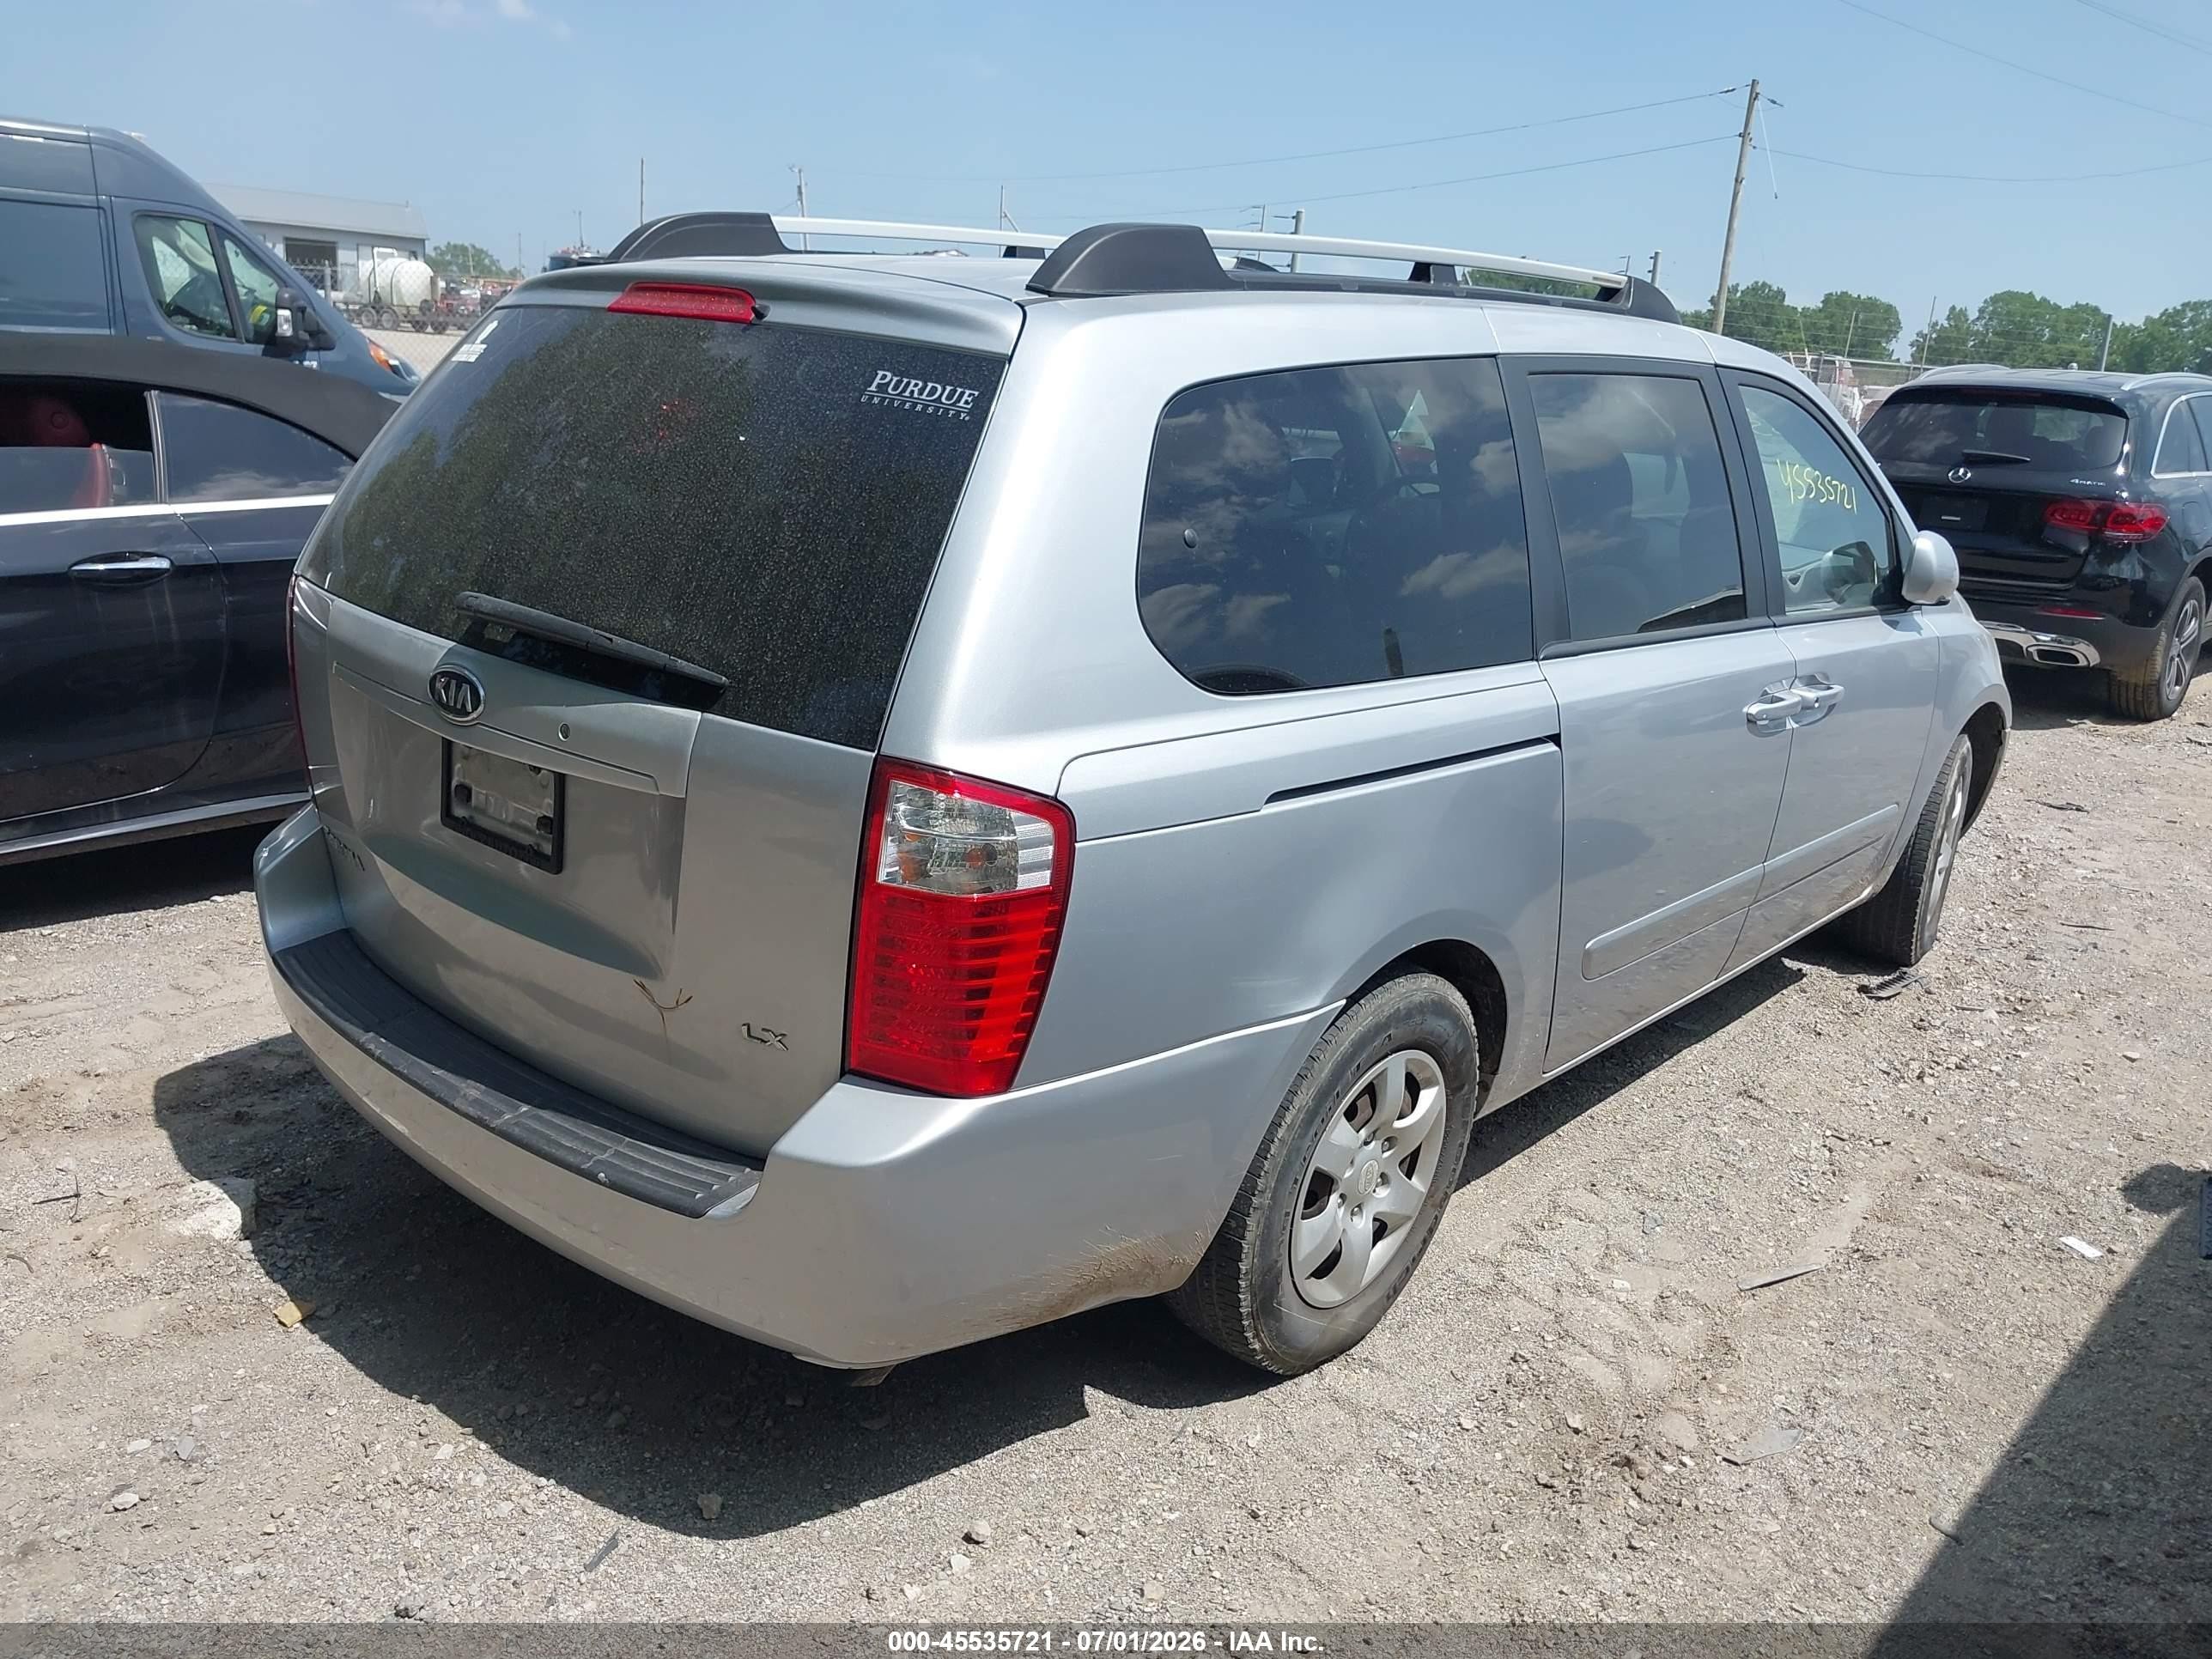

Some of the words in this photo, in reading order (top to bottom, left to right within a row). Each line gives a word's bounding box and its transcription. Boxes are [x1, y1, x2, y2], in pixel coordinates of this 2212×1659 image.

[860, 394, 968, 420] UNIVERSITY
[866, 370, 980, 409] PURDUE
[1776, 458, 1857, 516] 45535721
[434, 673, 472, 713] KIA
[741, 1022, 789, 1051] LX
